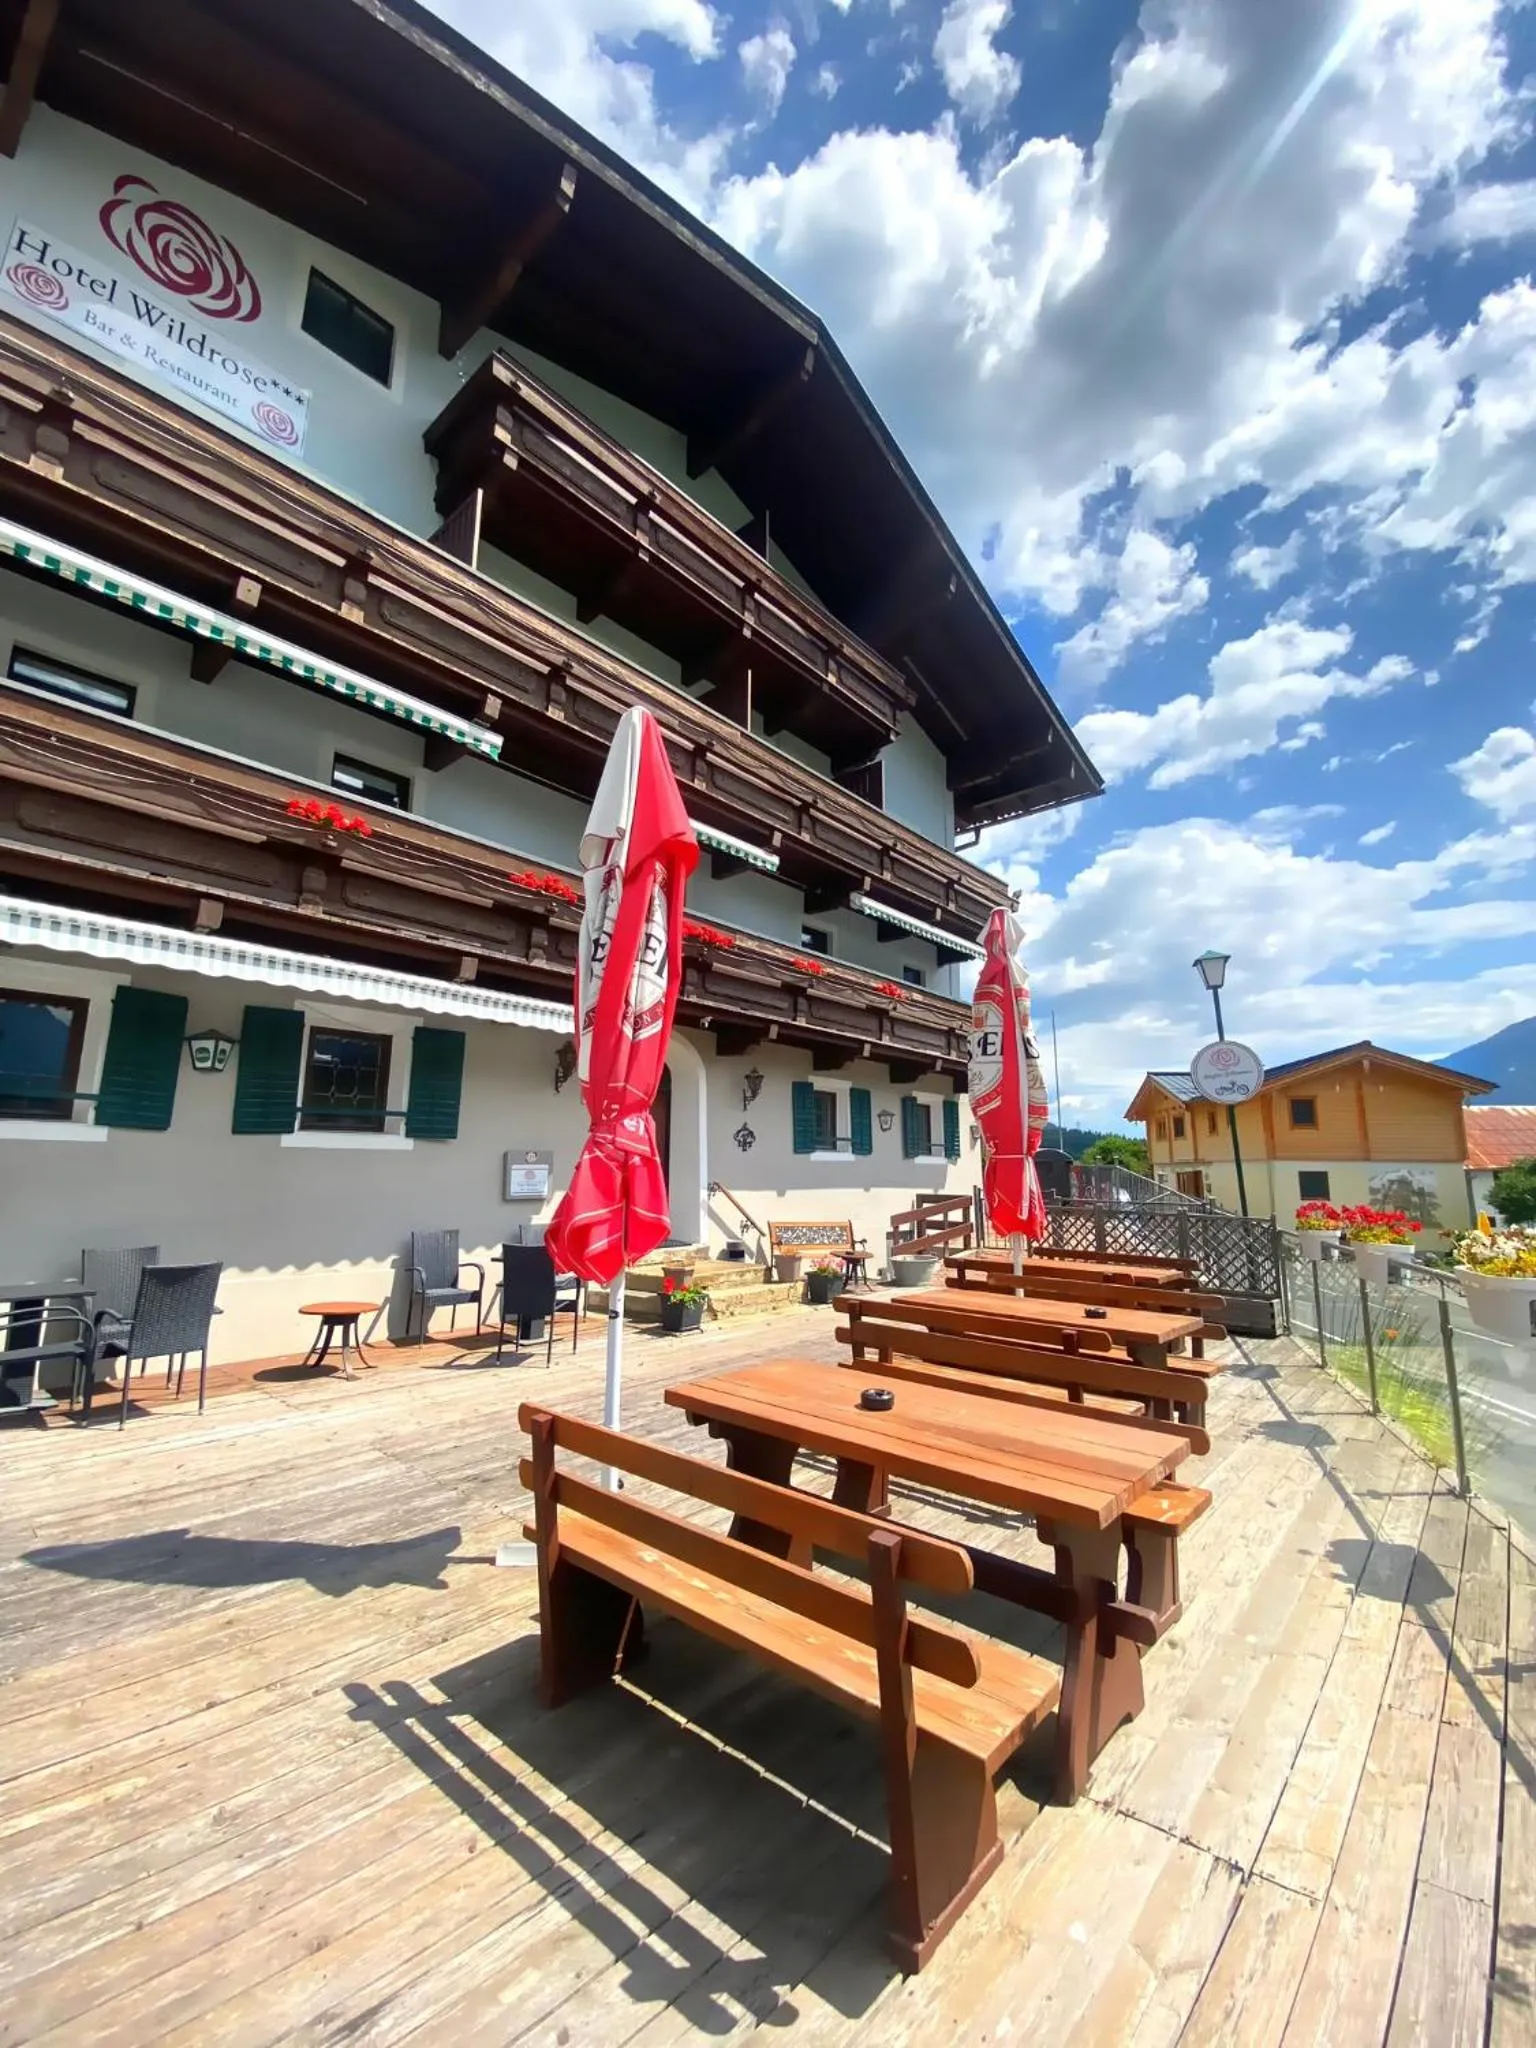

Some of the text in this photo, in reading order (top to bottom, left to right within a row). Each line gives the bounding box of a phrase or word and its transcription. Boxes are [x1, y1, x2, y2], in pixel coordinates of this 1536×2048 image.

[13, 228, 117, 303] Hotel
[84, 309, 240, 408] Bar & Restaurant
